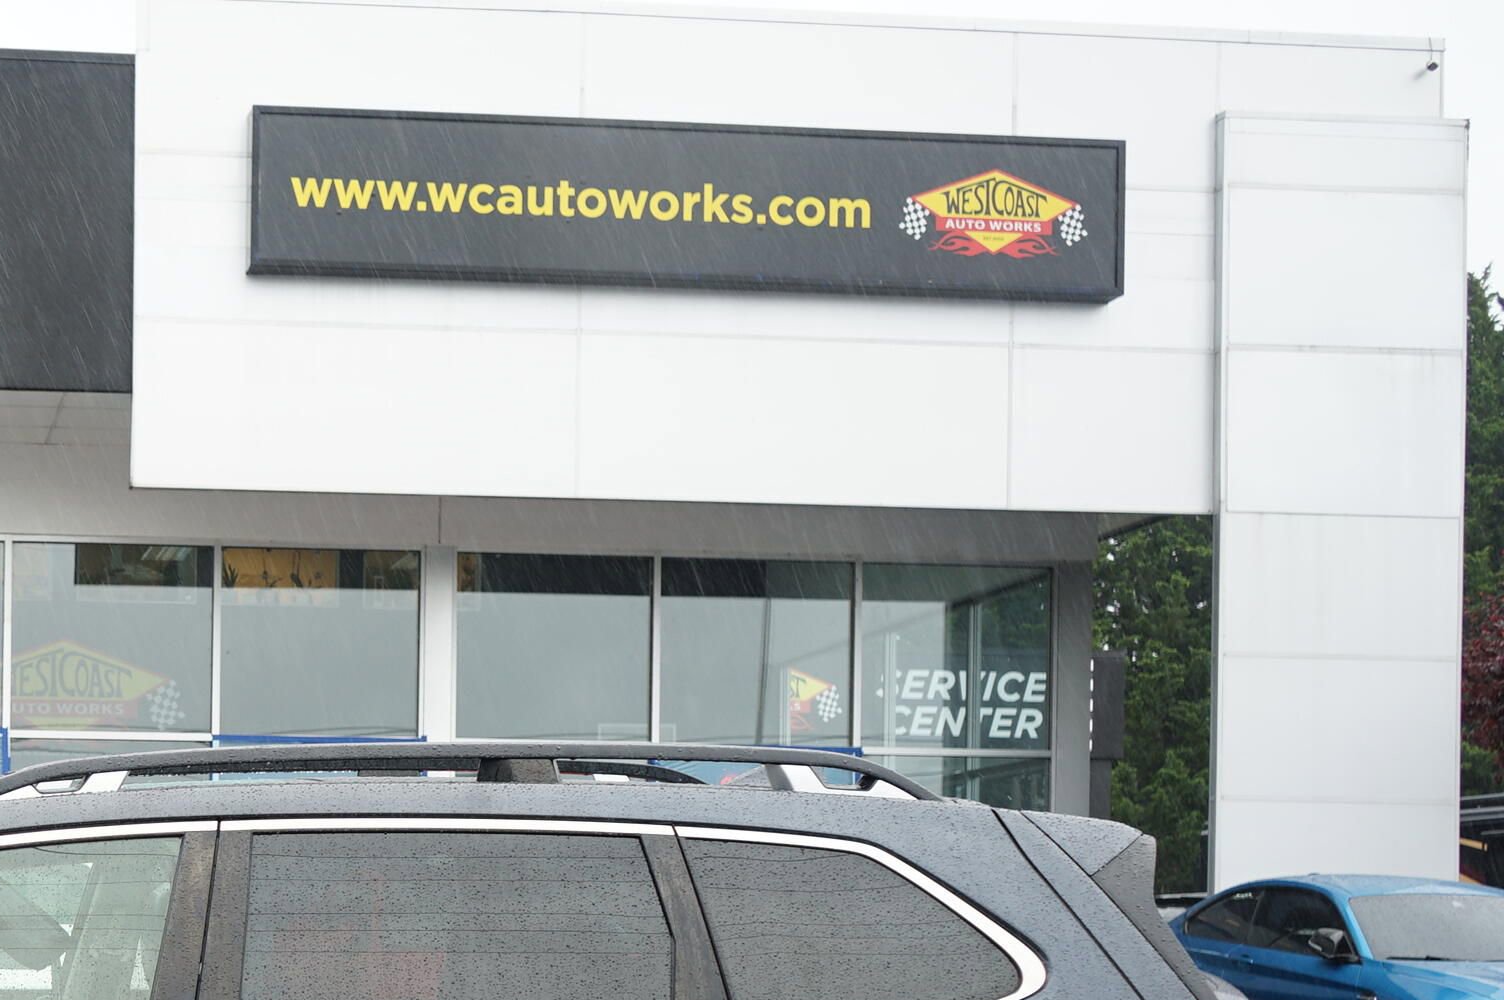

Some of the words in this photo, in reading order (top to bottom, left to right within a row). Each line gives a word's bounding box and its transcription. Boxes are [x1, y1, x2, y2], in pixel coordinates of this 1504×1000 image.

[291, 175, 871, 229] www.wcautoworks.com
[945, 218, 986, 230] AUTO
[990, 219, 1042, 232] WORKS
[9, 702, 56, 715] UTO
[57, 703, 125, 716] WORKS
